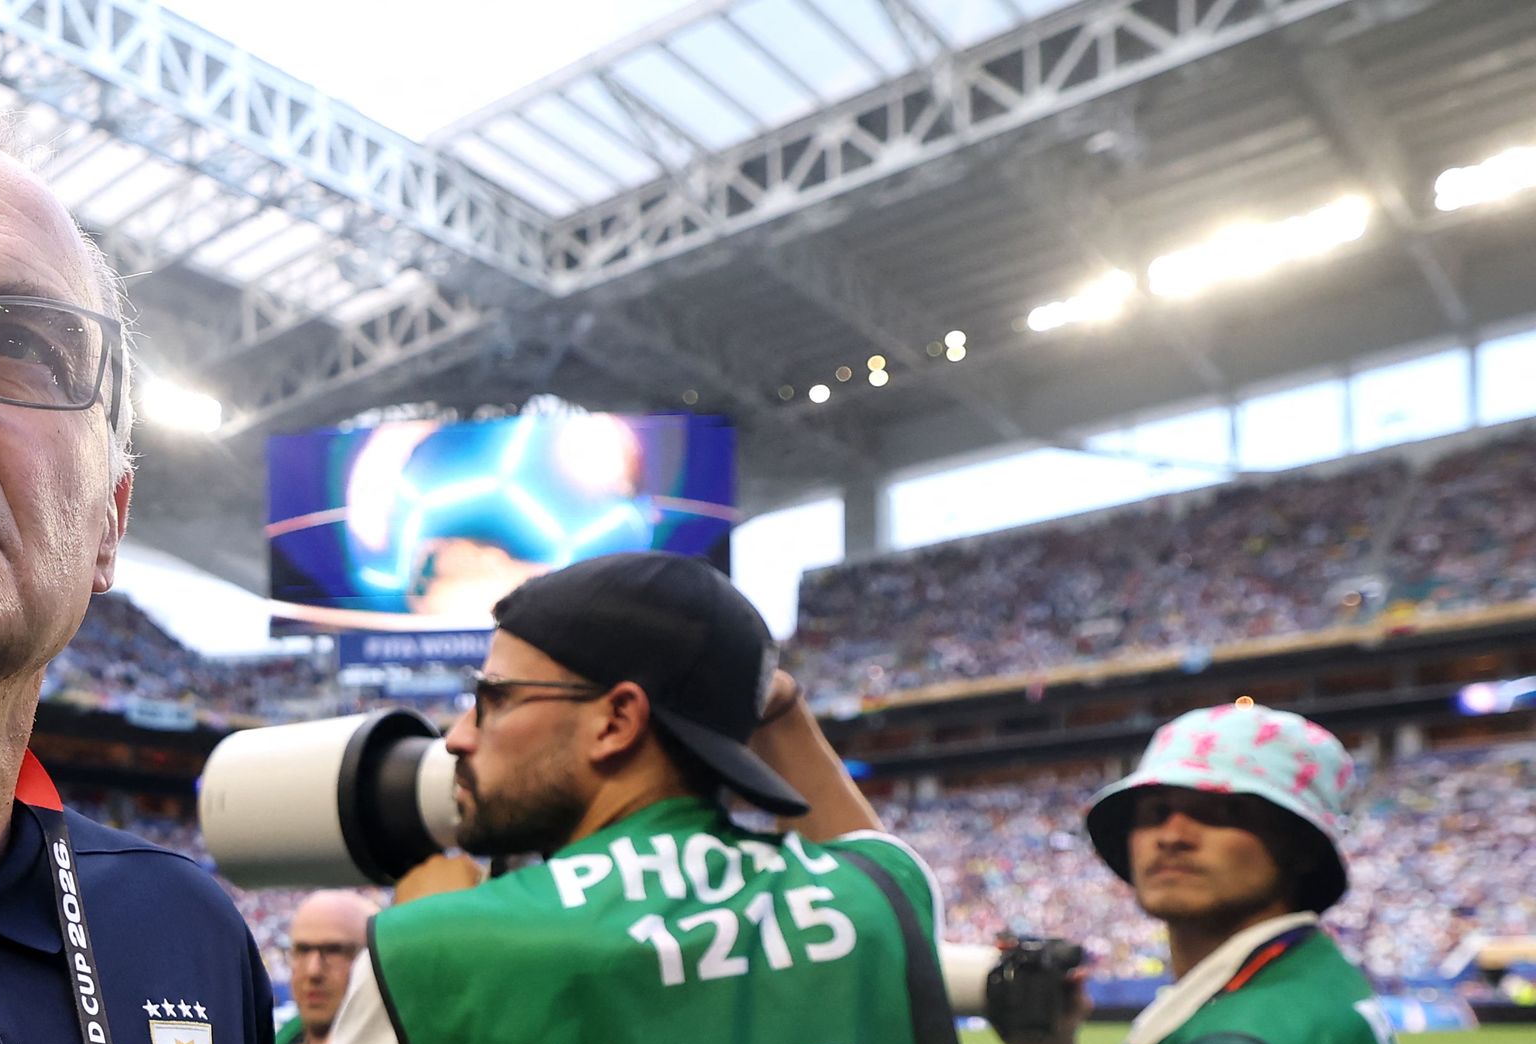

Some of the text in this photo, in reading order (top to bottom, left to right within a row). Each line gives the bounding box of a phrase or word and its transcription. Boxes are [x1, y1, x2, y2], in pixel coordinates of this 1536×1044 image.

[53, 841, 88, 949] 2026
[627, 885, 857, 987] 1215
[74, 952, 99, 1016] CUP
